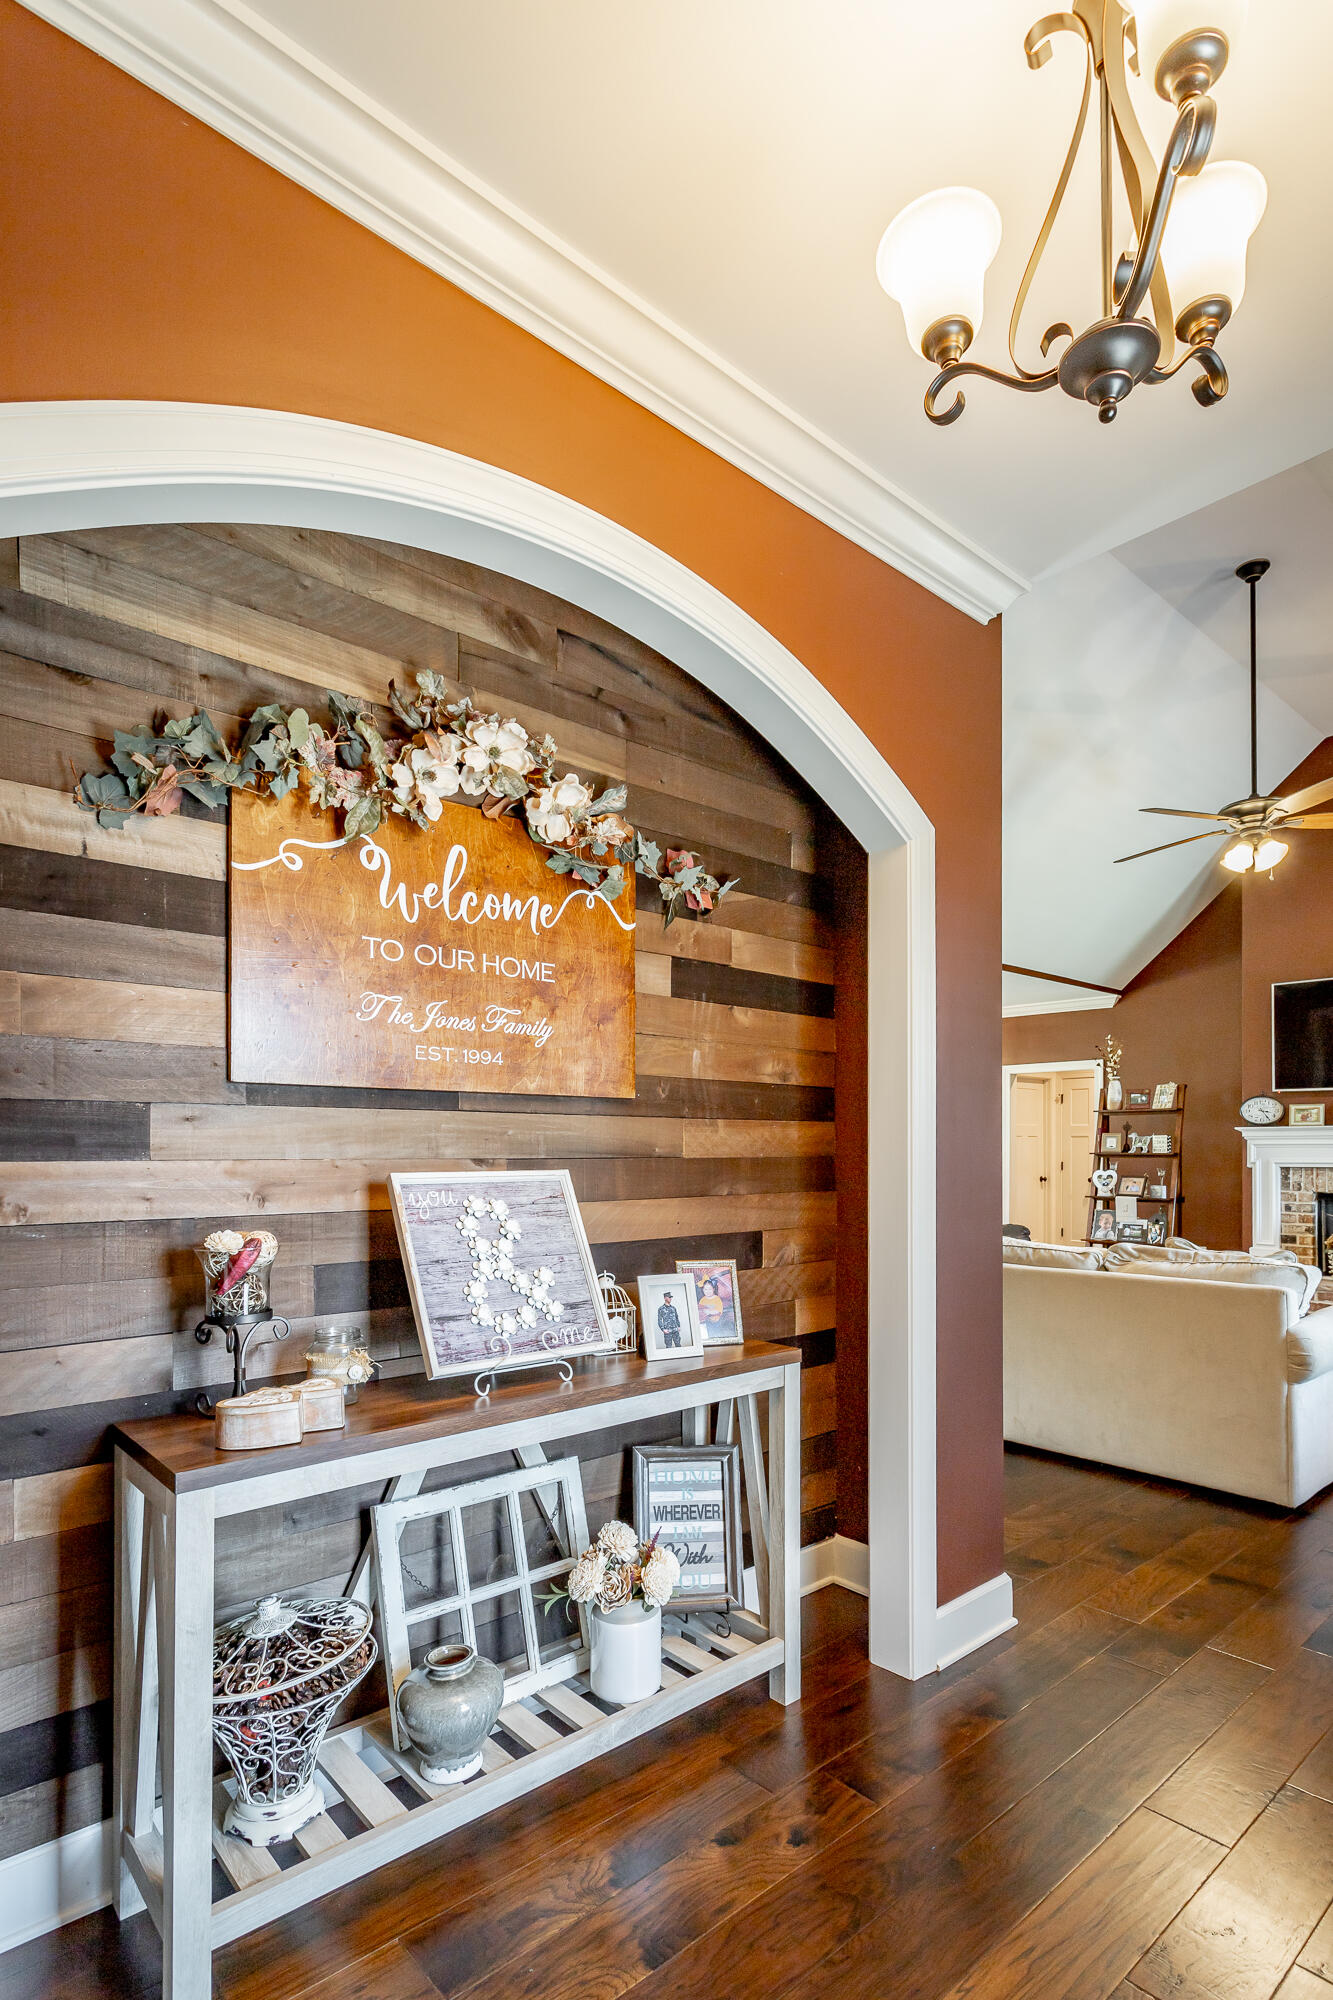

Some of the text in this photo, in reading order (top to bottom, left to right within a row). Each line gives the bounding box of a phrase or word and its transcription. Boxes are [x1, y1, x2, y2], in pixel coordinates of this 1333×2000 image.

[360, 834, 557, 936] Welcome
[362, 935, 556, 983] TO OUR HOME
[356, 991, 554, 1048] The Jones Family
[414, 1045, 504, 1066] EST. 1994
[408, 1189, 458, 1219] you
[559, 1325, 595, 1344] me
[653, 1469, 719, 1486] HOME
[681, 1487, 694, 1501] IS
[653, 1503, 720, 1522] WHEREVER
[673, 1525, 704, 1540] I AM
[678, 1571, 712, 1590] OU
